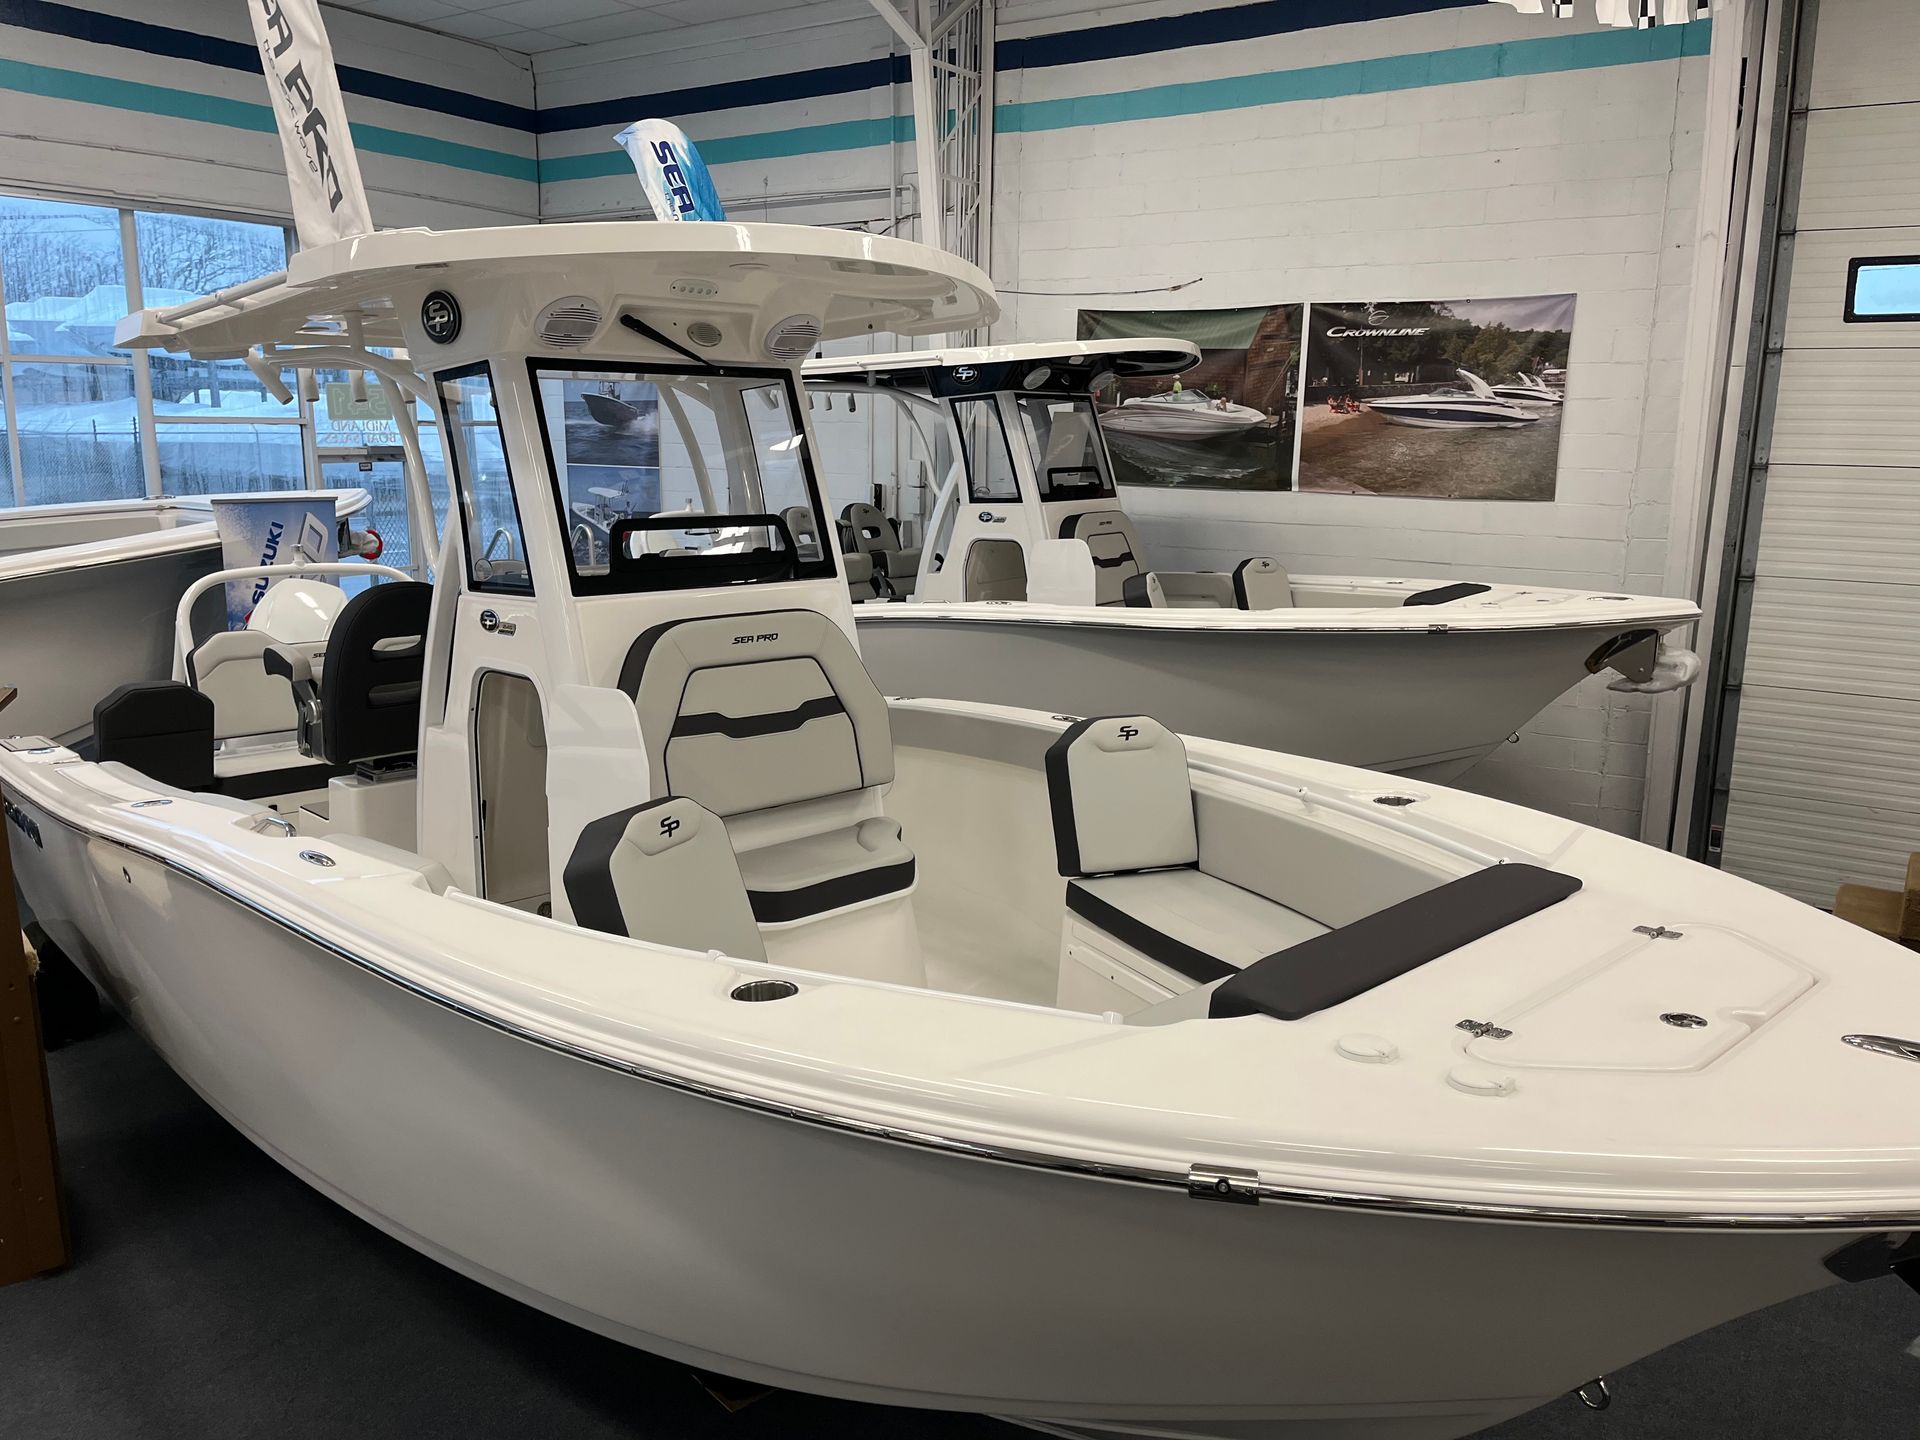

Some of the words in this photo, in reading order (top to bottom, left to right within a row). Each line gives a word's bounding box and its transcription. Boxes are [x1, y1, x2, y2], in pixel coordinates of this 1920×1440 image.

[284, 59, 343, 213] PRO
[295, 120, 318, 174] wave
[650, 141, 695, 213] SEA
[1326, 326, 1430, 337] CROWNLINE
[732, 635, 754, 645] SEA
[756, 633, 779, 642] PRO
